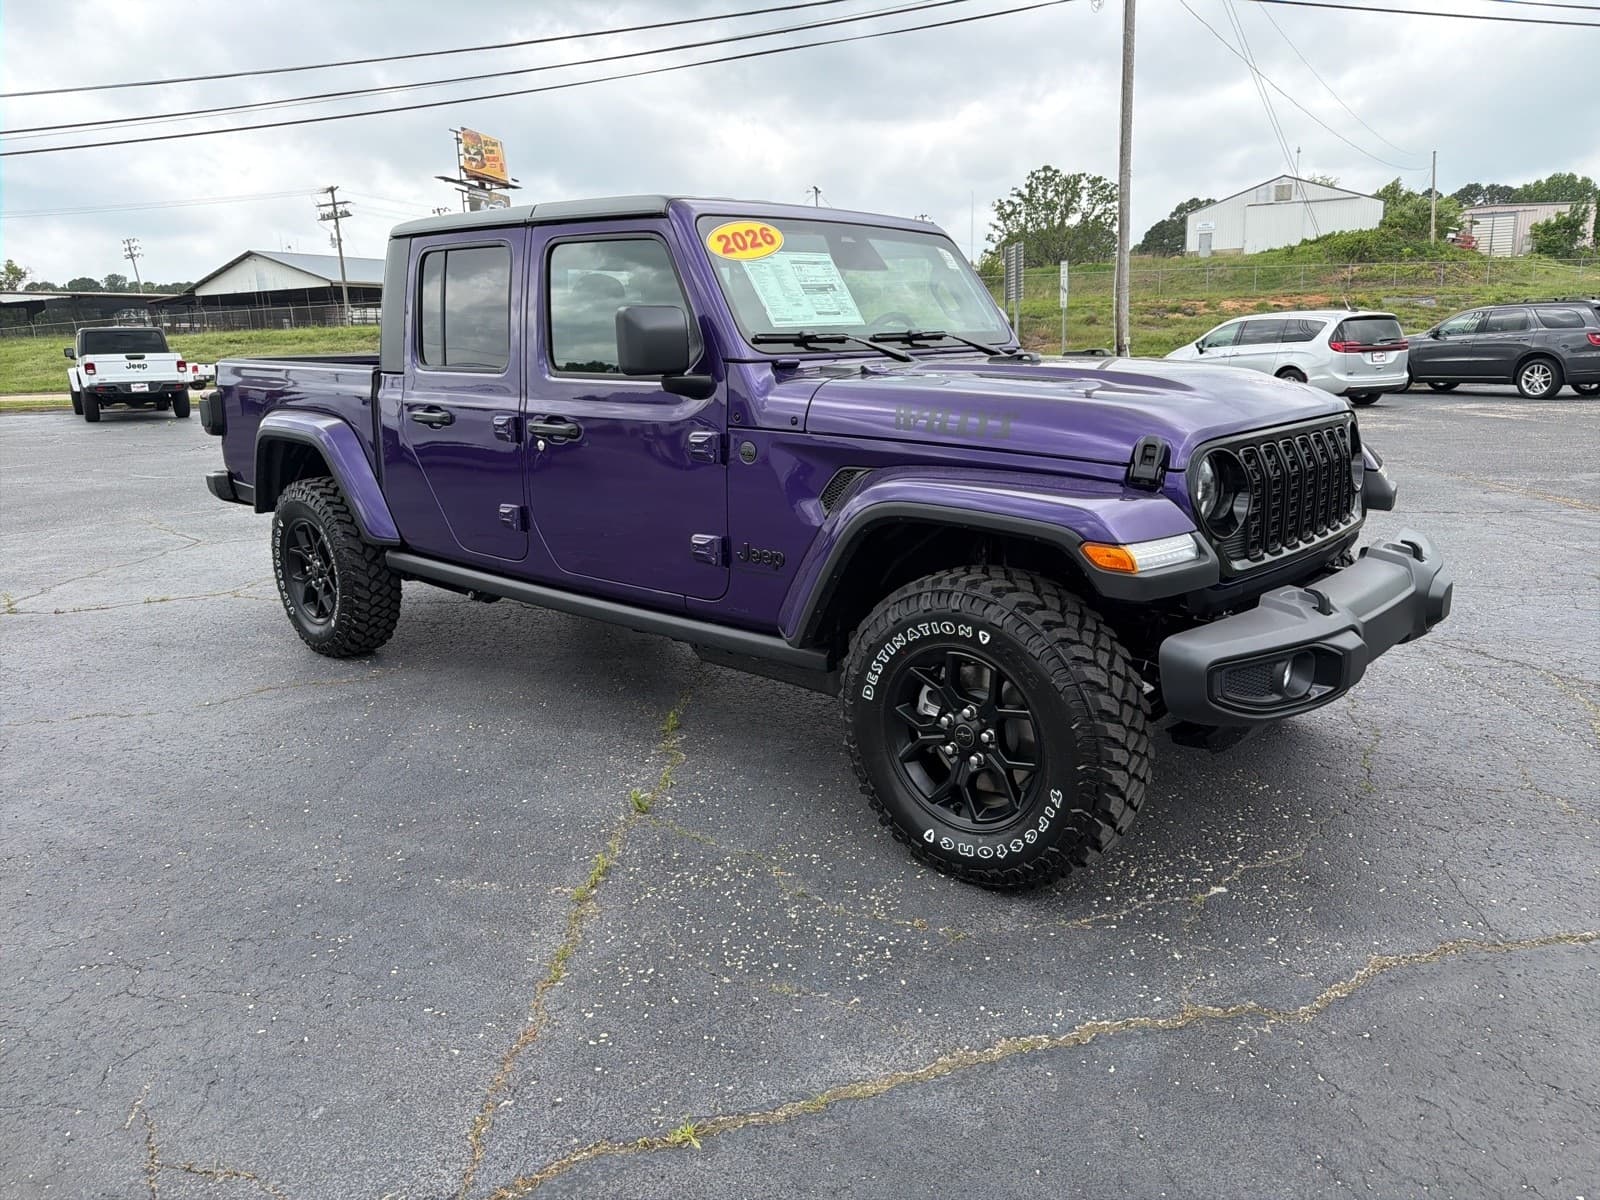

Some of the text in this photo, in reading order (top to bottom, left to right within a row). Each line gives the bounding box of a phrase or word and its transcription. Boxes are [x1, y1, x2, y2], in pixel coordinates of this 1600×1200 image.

[716, 226, 777, 255] 2026
[125, 362, 148, 370] Jeep
[736, 542, 785, 571] Jeep
[862, 621, 973, 701] DESTINATION
[939, 788, 1063, 859] Firestone
